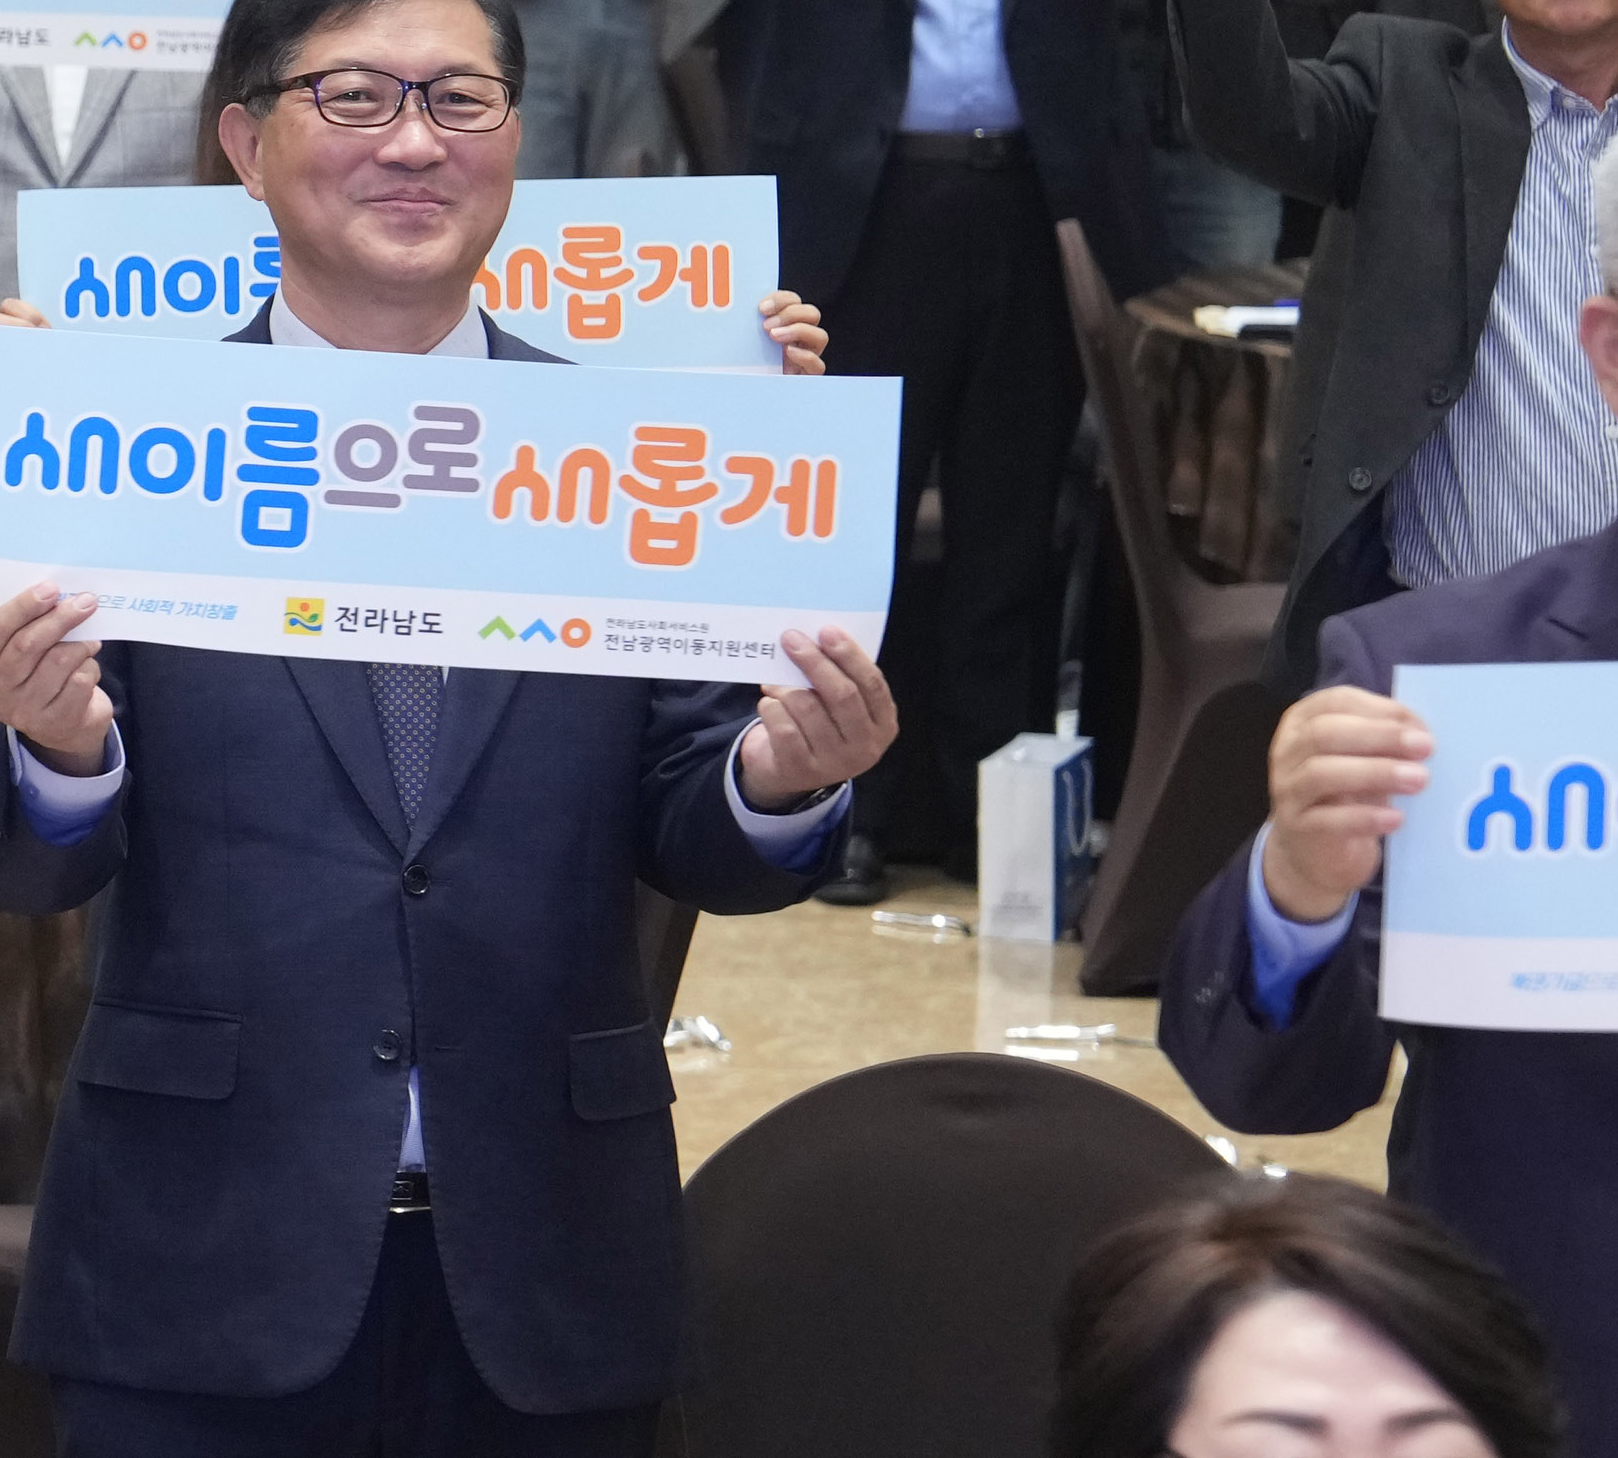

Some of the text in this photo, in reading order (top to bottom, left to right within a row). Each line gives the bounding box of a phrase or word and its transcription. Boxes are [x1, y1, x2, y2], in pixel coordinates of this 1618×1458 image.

[475, 224, 731, 341] 새롭게
[4, 404, 838, 566] 새이름으로 새롭게
[127, 596, 176, 616] 사회적
[175, 601, 239, 621] 가치창출
[334, 606, 444, 636] 전라남도
[605, 617, 711, 634] 전라남도사회서비스원
[604, 632, 776, 660] 전남광역이동지원센터
